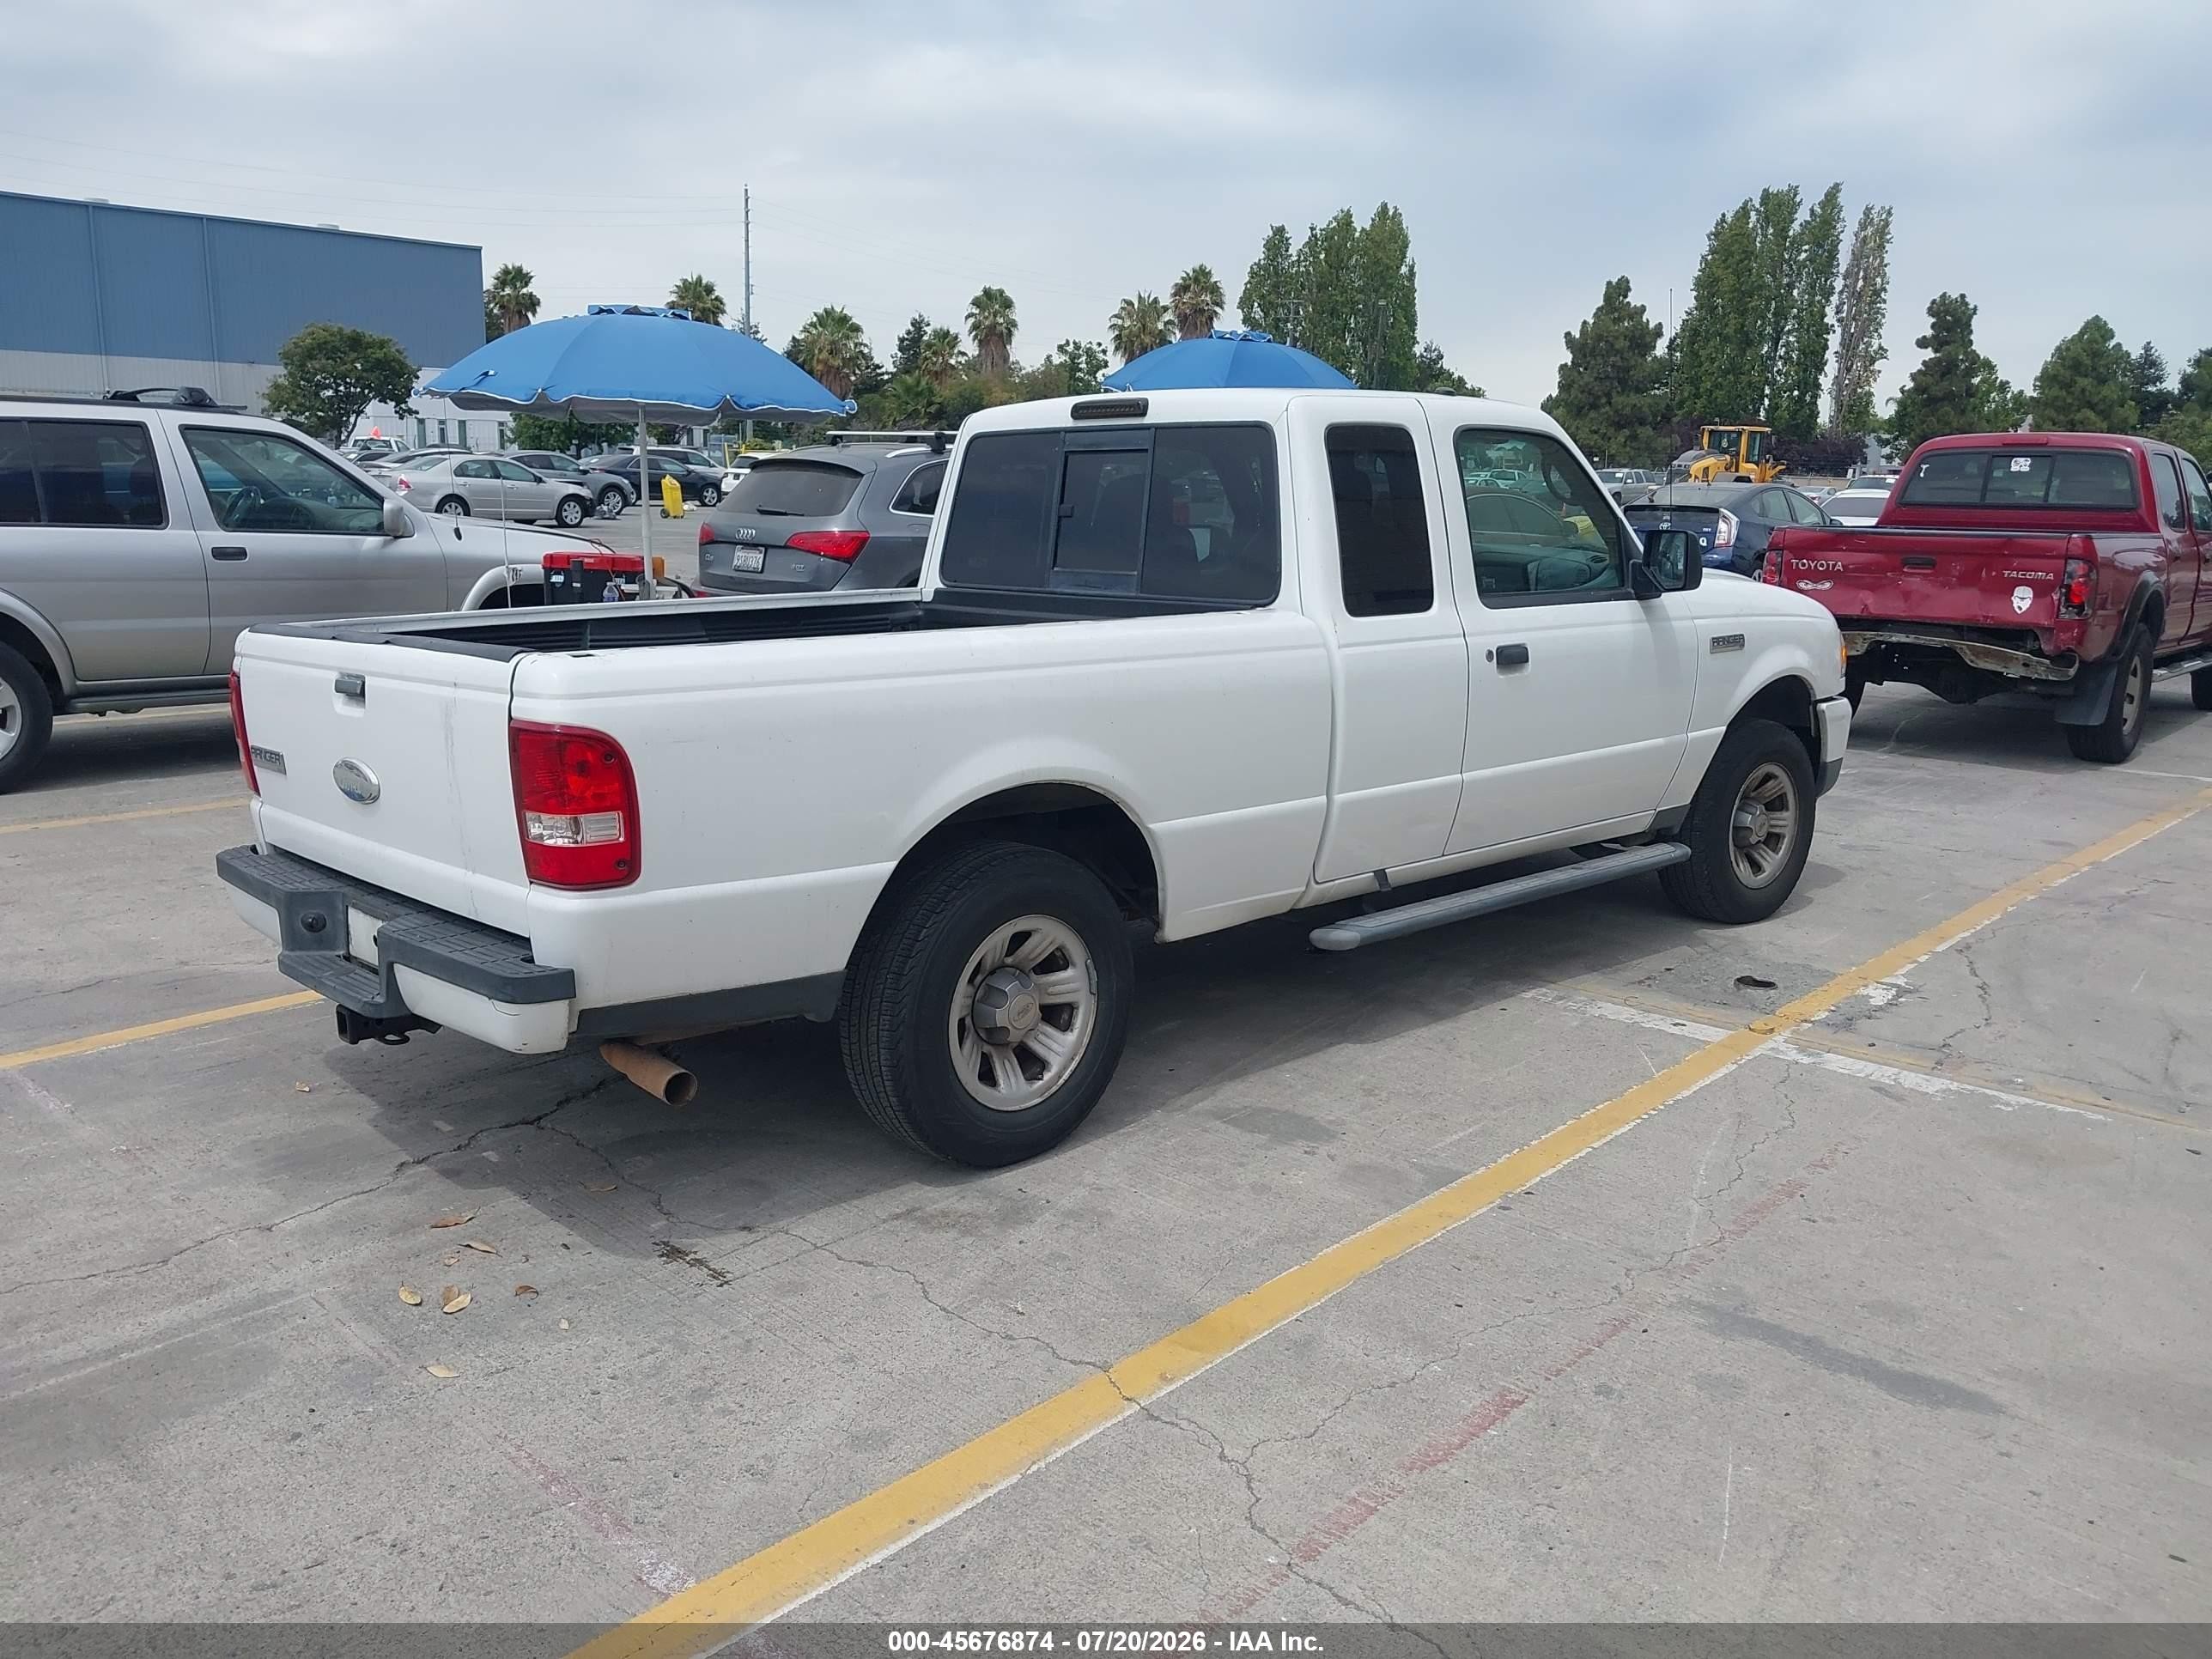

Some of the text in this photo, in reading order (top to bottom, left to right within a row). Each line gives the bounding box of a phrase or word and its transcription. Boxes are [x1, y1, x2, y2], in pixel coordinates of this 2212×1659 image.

[1790, 559, 1844, 572] TOYOTA
[2002, 570, 2055, 580] TACOMA
[1711, 634, 1745, 647] RANGER
